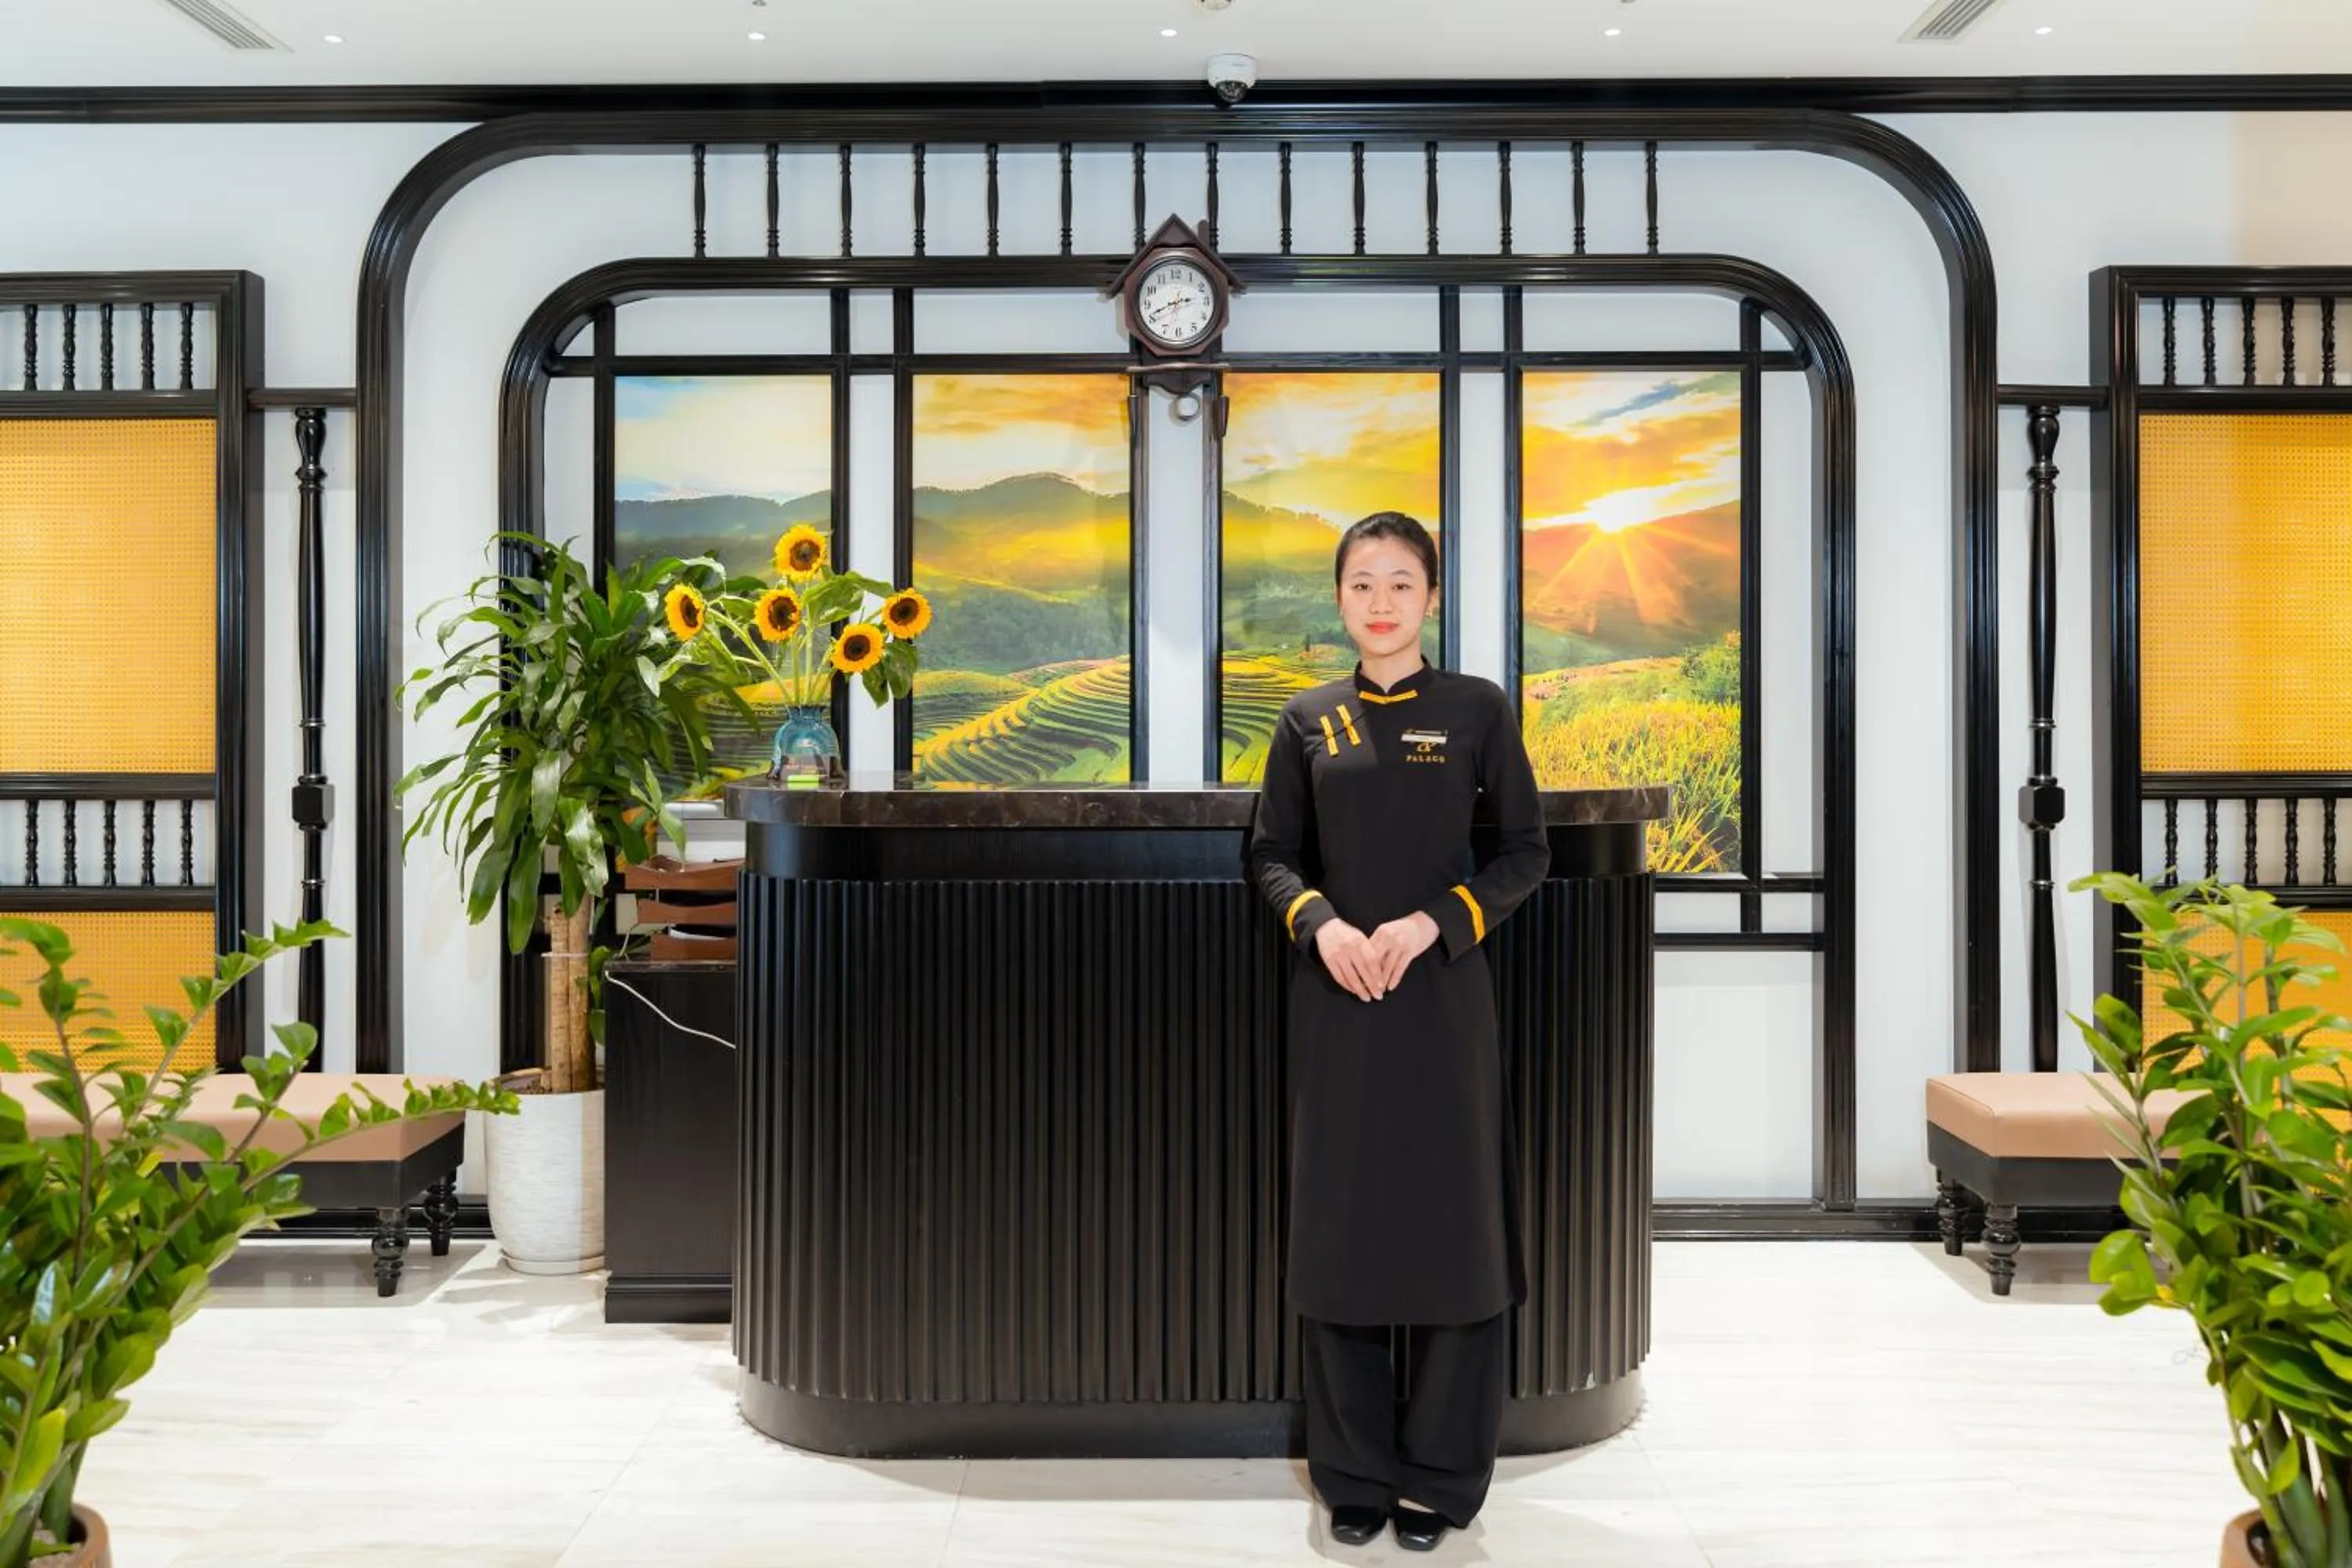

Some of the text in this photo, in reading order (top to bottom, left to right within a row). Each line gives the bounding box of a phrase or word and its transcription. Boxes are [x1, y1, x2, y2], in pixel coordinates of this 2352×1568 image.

[1157, 274, 1166, 284] 11
[1171, 269, 1181, 279] 12
[1189, 273, 1192, 282] 1
[1147, 285, 1156, 296] 10
[1198, 281, 1205, 292] 2
[1144, 299, 1151, 310] 9
[1149, 314, 1156, 323] 8
[1162, 325, 1168, 334] 7
[1191, 322, 1197, 332] 5
